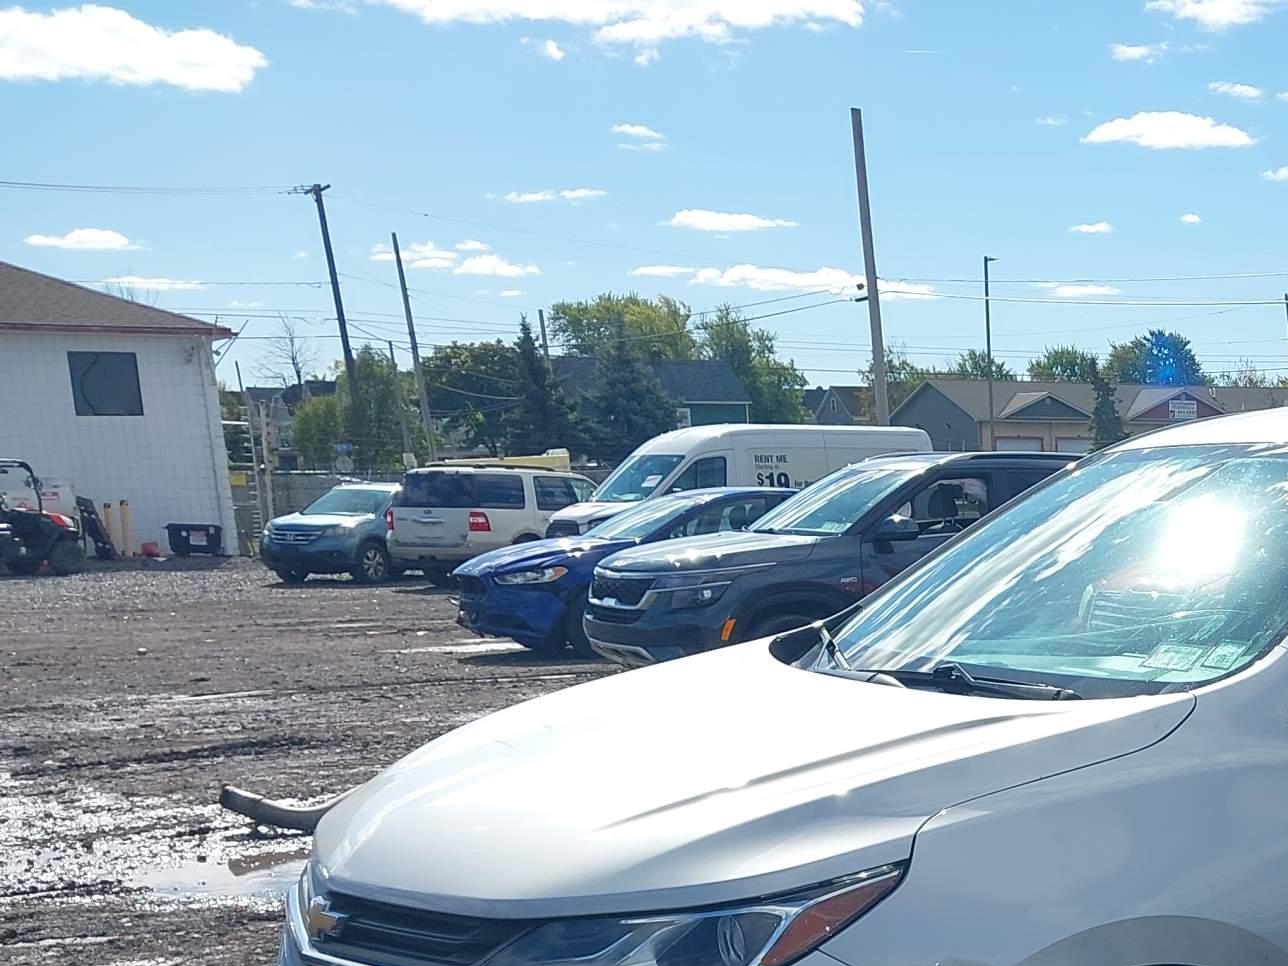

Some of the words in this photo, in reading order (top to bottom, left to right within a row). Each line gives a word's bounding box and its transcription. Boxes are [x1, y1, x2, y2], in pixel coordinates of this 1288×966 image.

[754, 454, 773, 464] RENT
[776, 454, 788, 464] ME
[756, 472, 790, 488] $19
